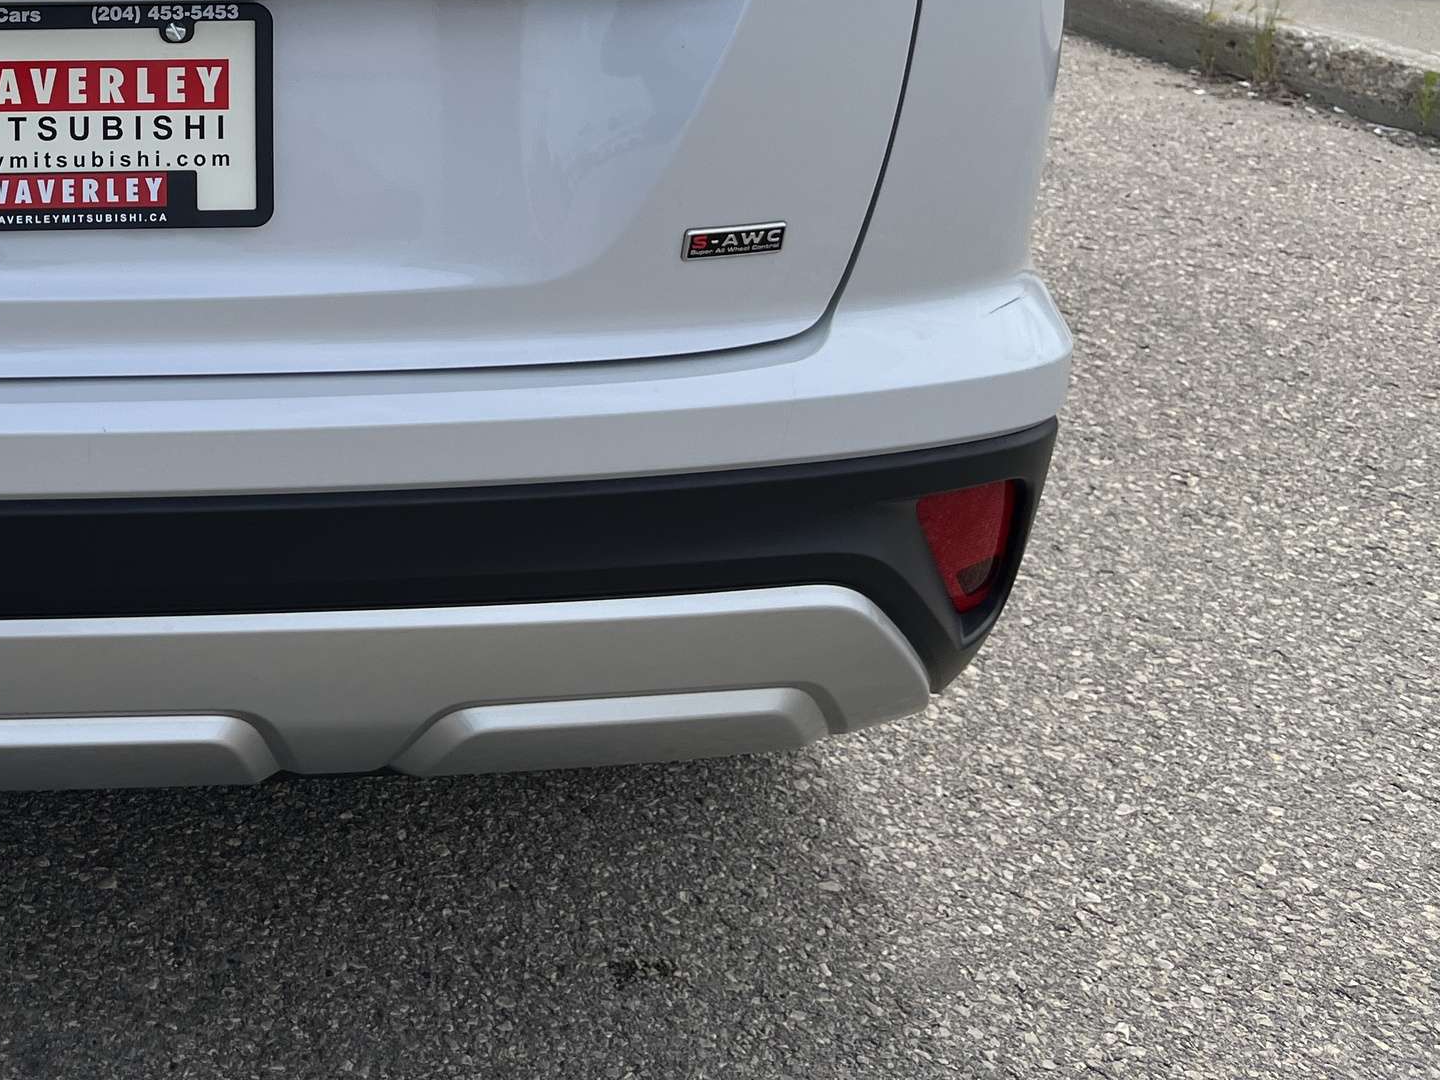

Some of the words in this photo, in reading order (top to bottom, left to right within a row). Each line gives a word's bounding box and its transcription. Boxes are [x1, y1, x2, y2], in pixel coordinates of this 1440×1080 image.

[91, 6, 141, 24] (204)
[147, 4, 240, 20] 453-5453
[691, 229, 782, 249] S-AWC
